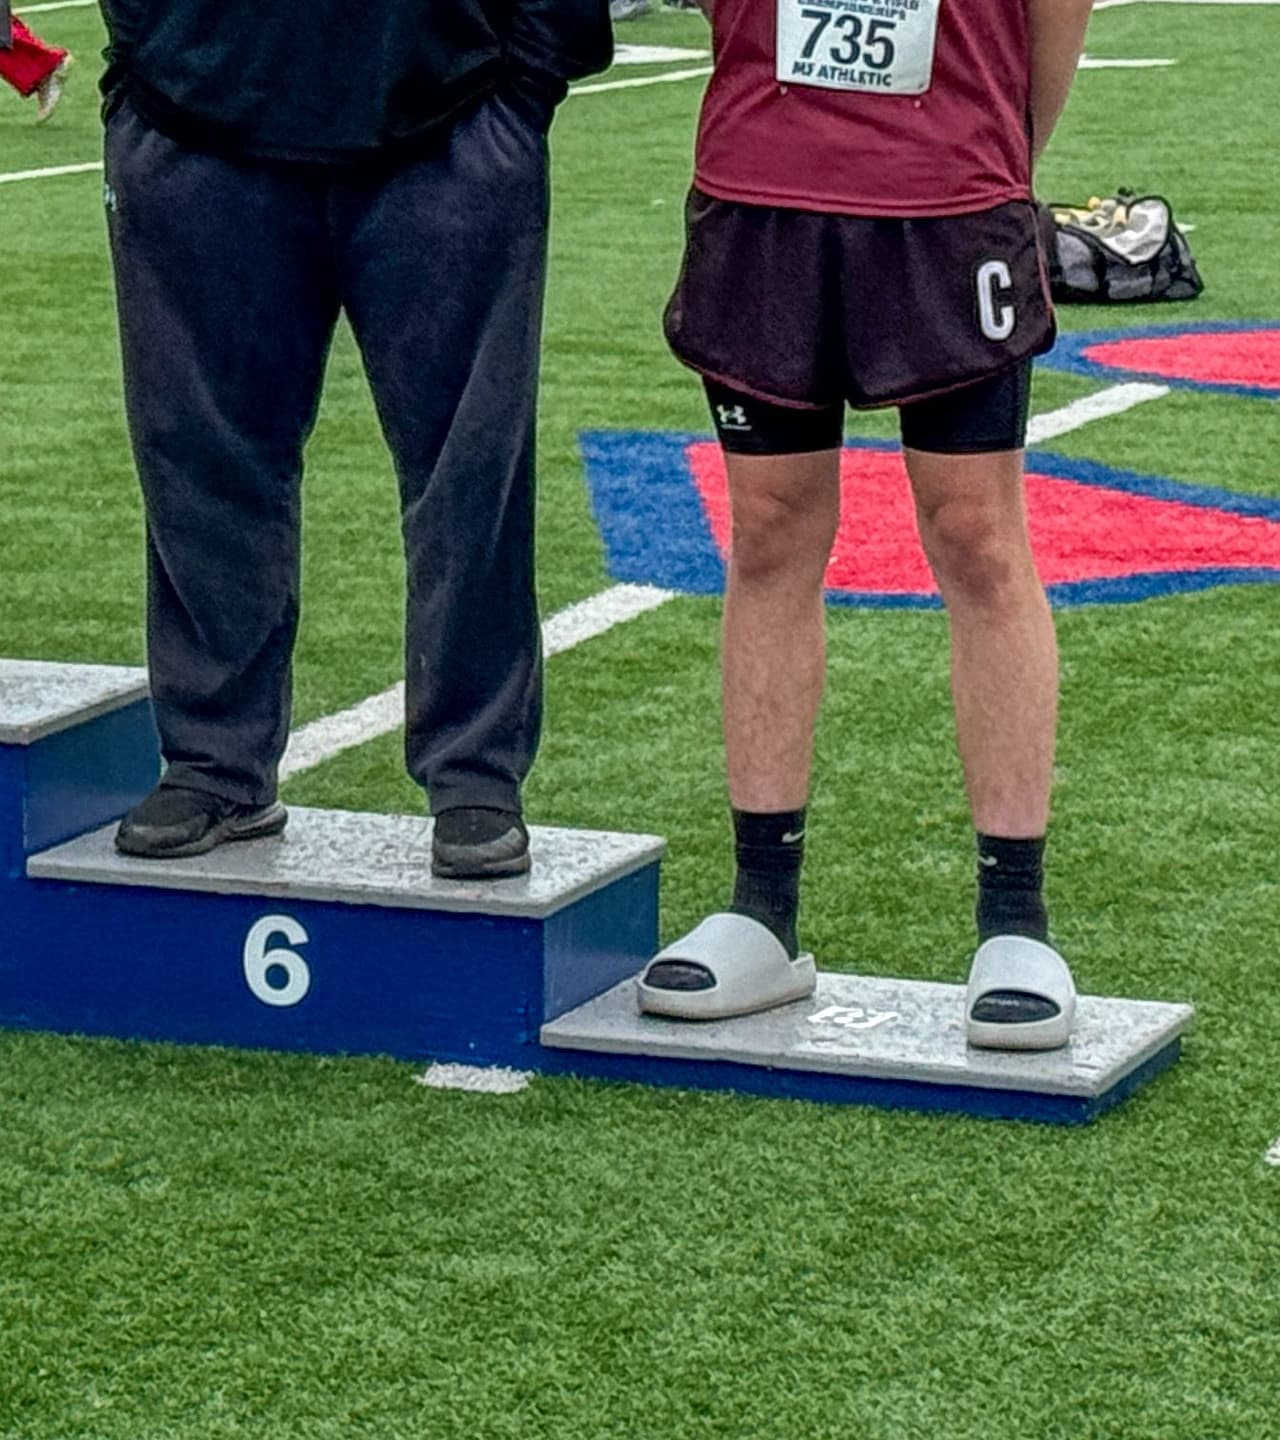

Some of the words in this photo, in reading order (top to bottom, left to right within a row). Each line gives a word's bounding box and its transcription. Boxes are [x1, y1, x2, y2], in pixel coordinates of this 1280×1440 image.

[800, 9, 896, 70] 735
[817, 64, 892, 88] ATHLETIC
[977, 260, 1015, 340] C
[243, 915, 311, 1006] 6
